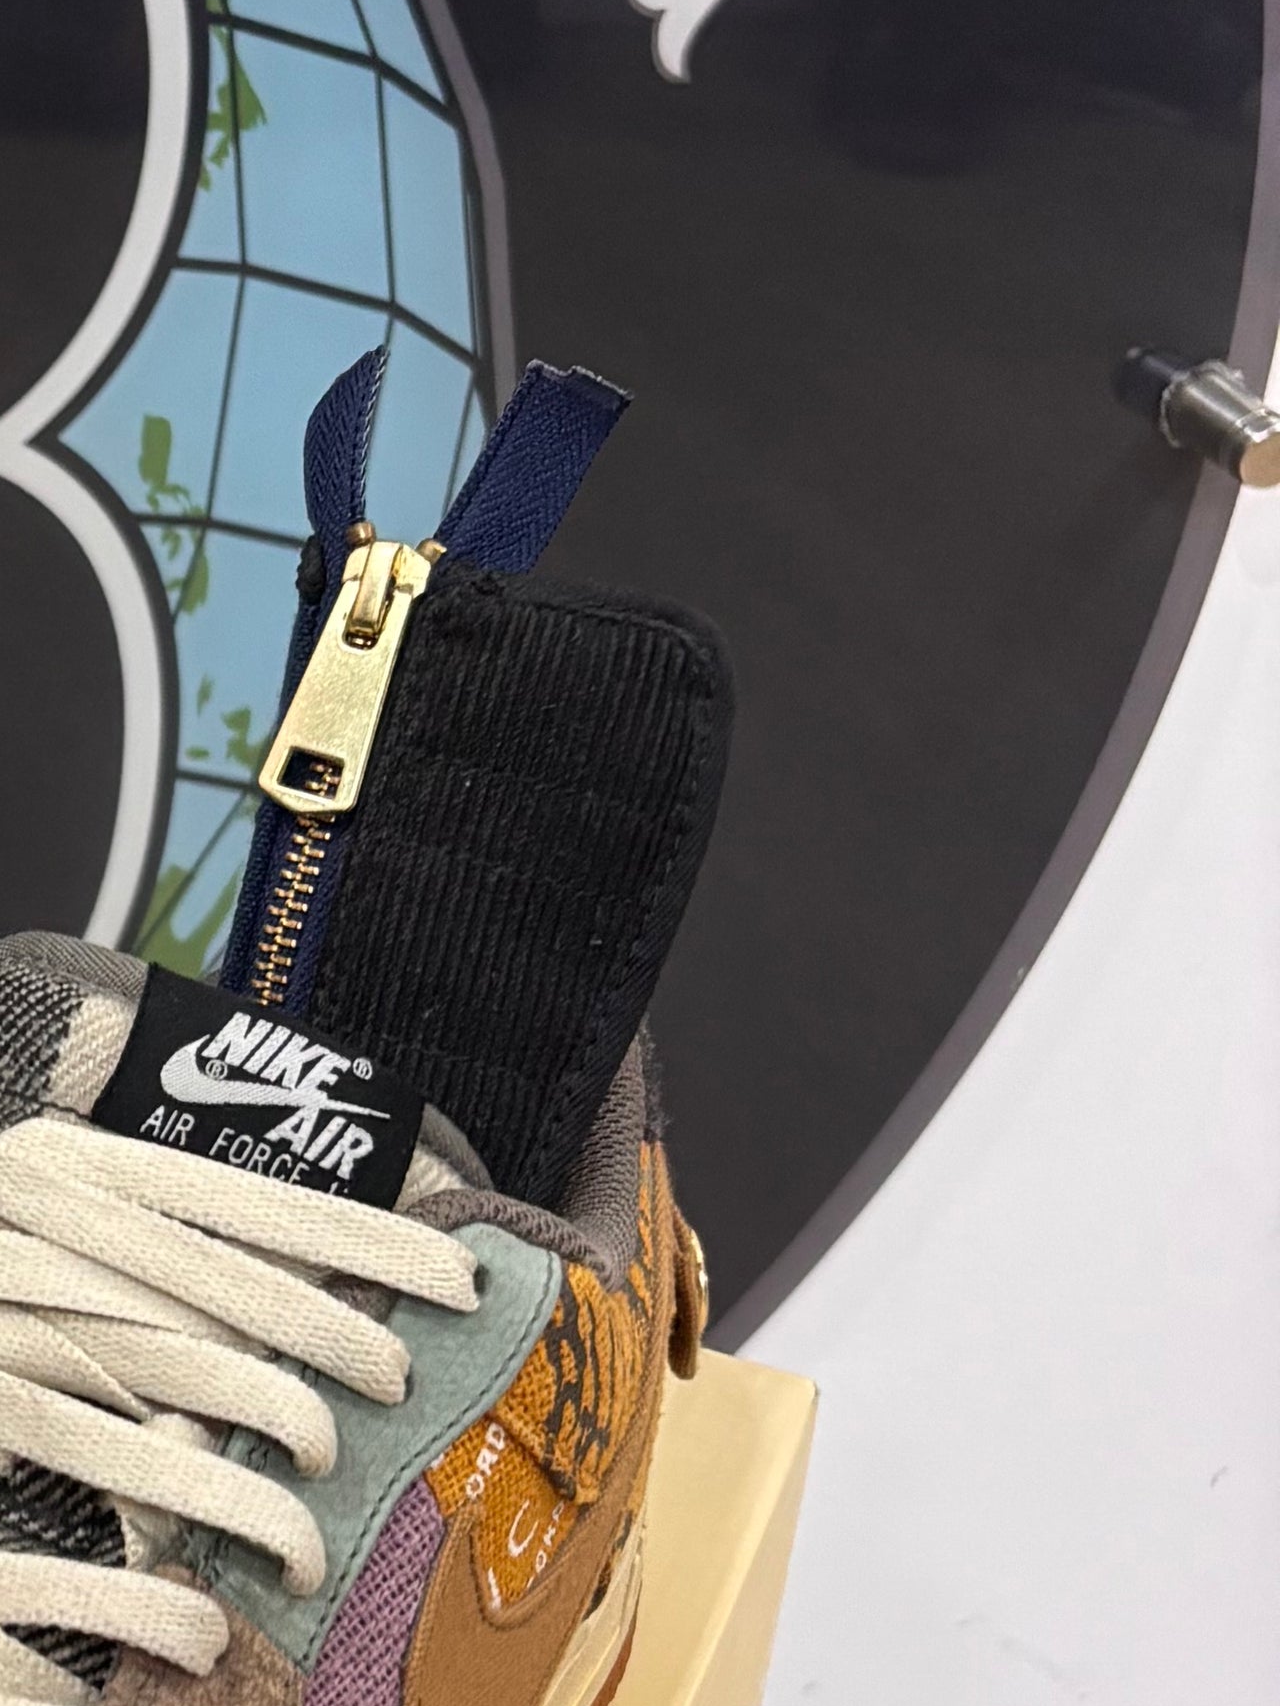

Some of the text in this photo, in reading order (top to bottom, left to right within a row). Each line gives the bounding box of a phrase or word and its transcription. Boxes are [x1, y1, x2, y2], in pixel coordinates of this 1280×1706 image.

[201, 1011, 352, 1090] NIKE
[139, 1104, 311, 1186] AIR FORCE
[263, 1104, 375, 1181] AIR
